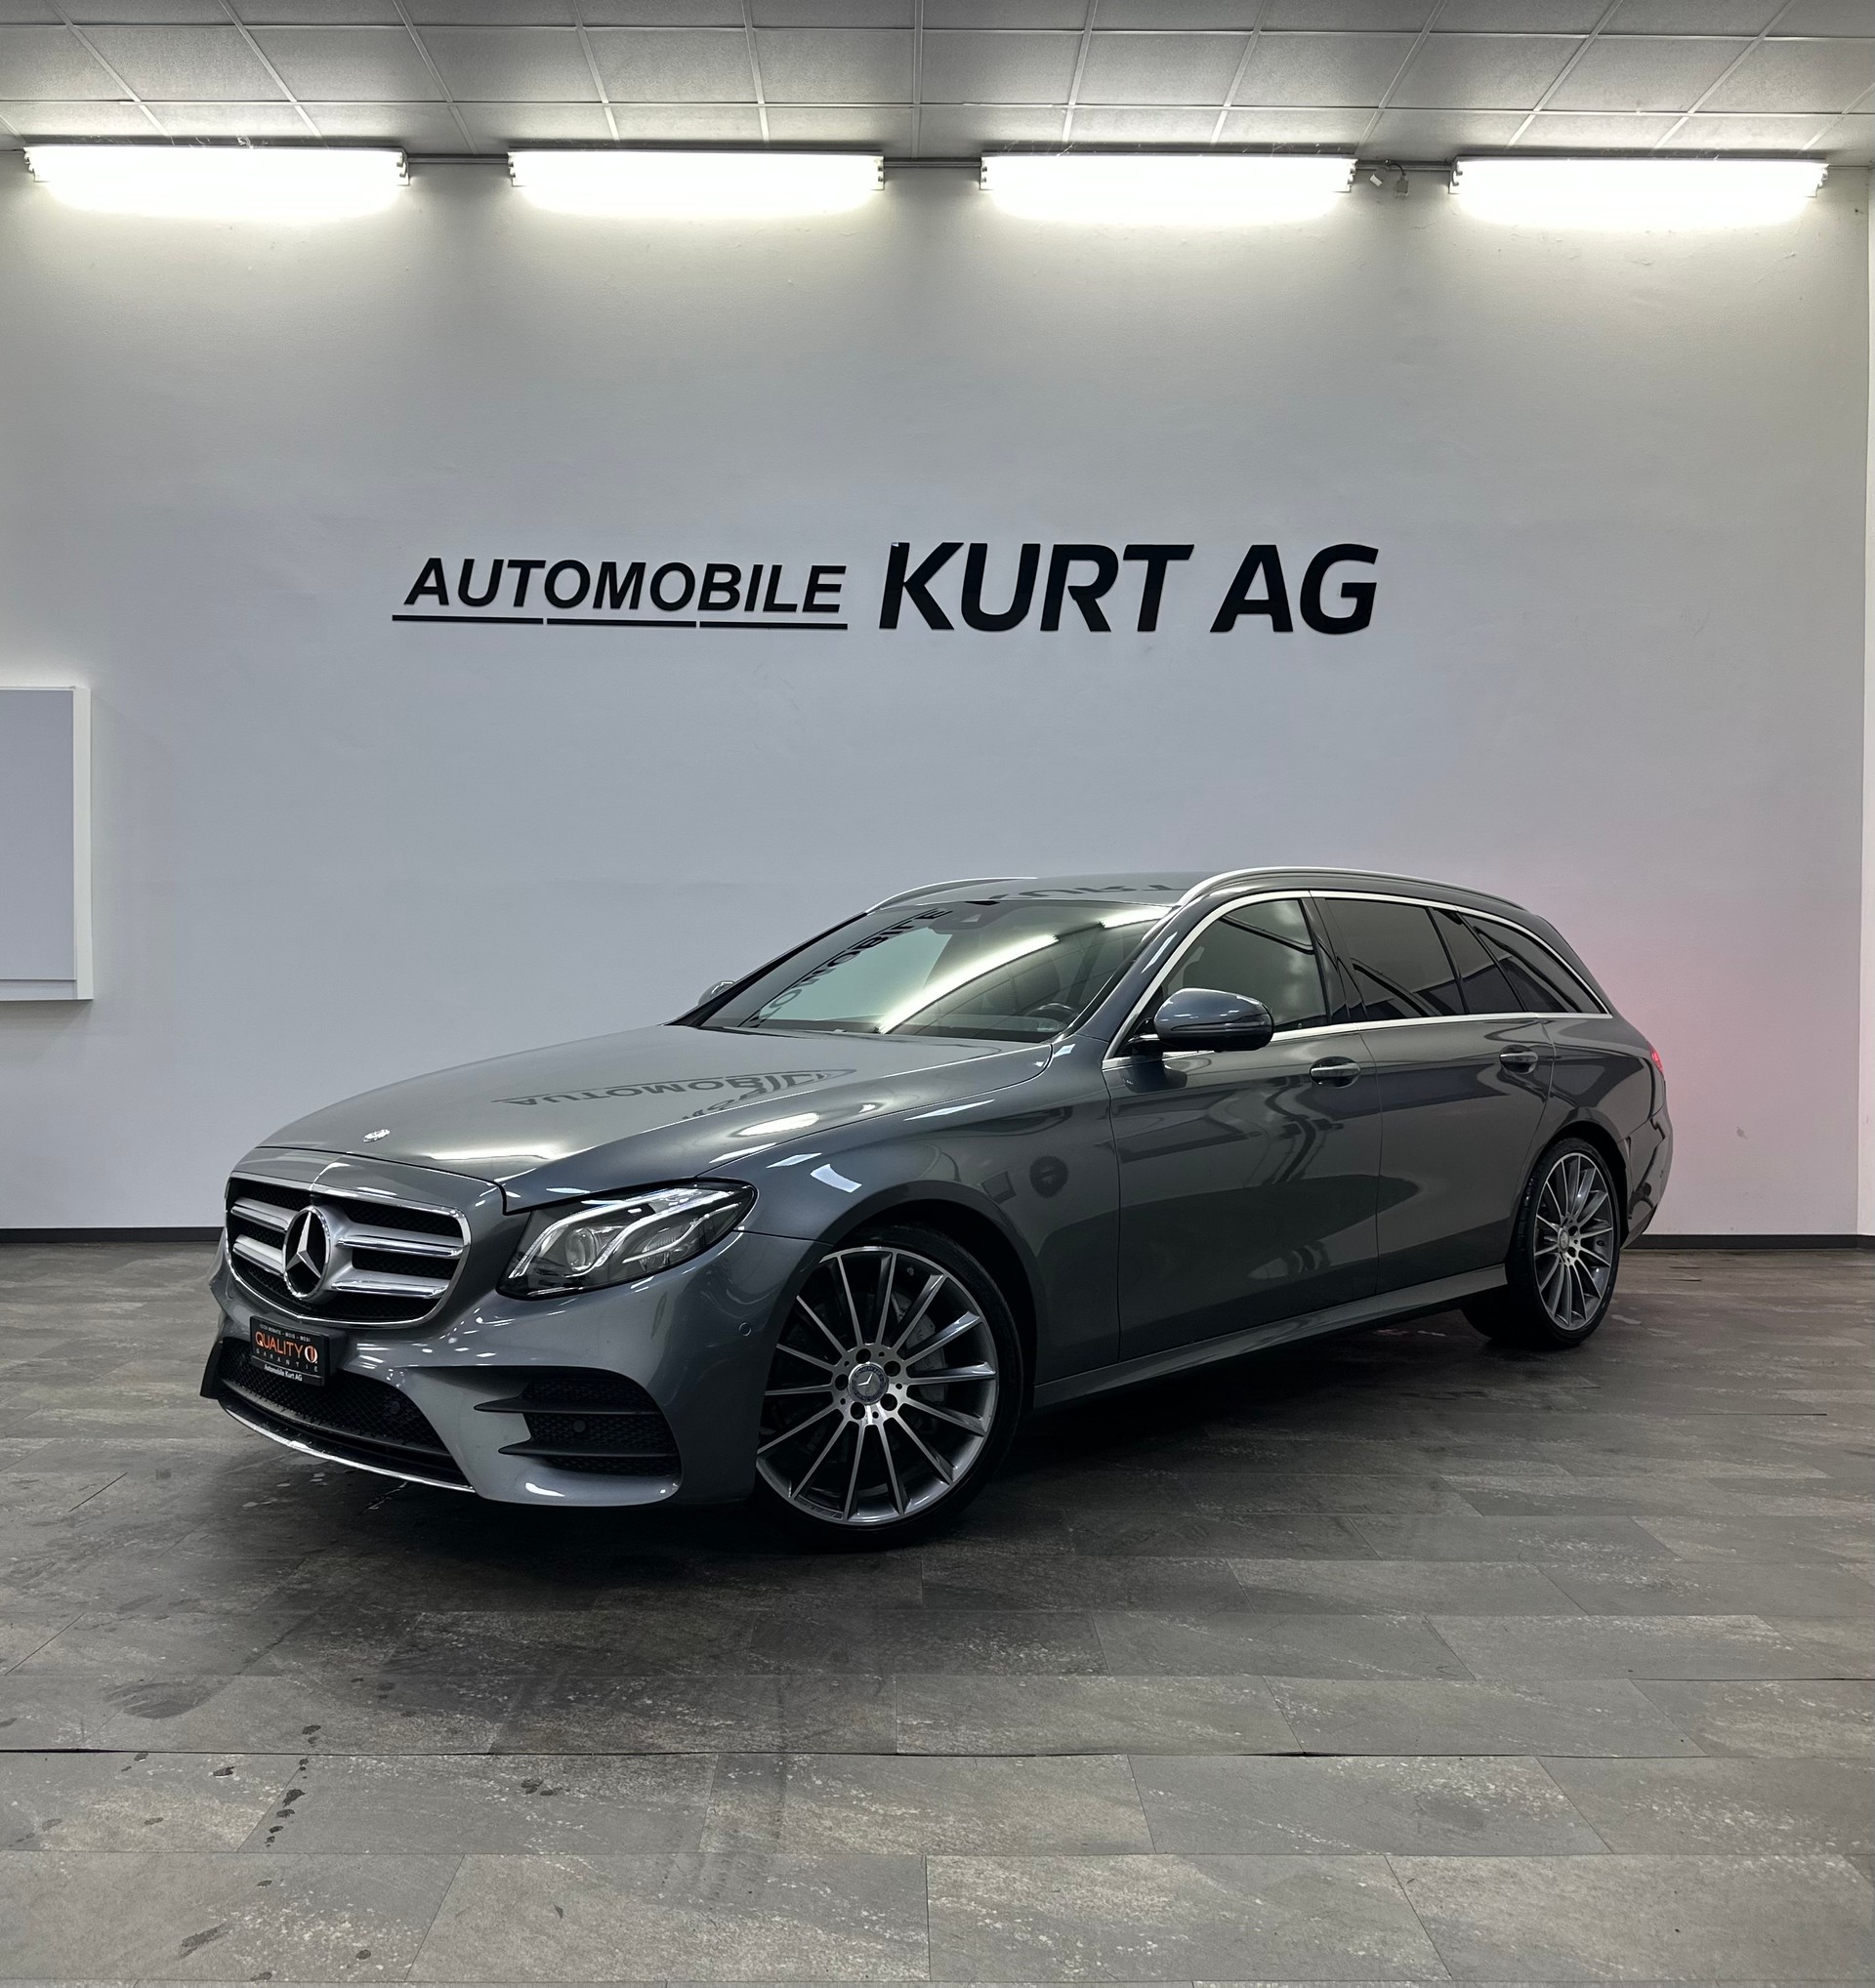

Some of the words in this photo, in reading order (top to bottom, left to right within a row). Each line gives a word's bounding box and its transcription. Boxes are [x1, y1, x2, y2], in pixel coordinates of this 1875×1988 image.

[403, 557, 847, 613] AUTOMOBILE
[879, 541, 1194, 632] KURT
[1209, 543, 1379, 635] AG
[255, 1331, 304, 1358] QUALITY
[256, 1348, 317, 1372] GARANTIE
